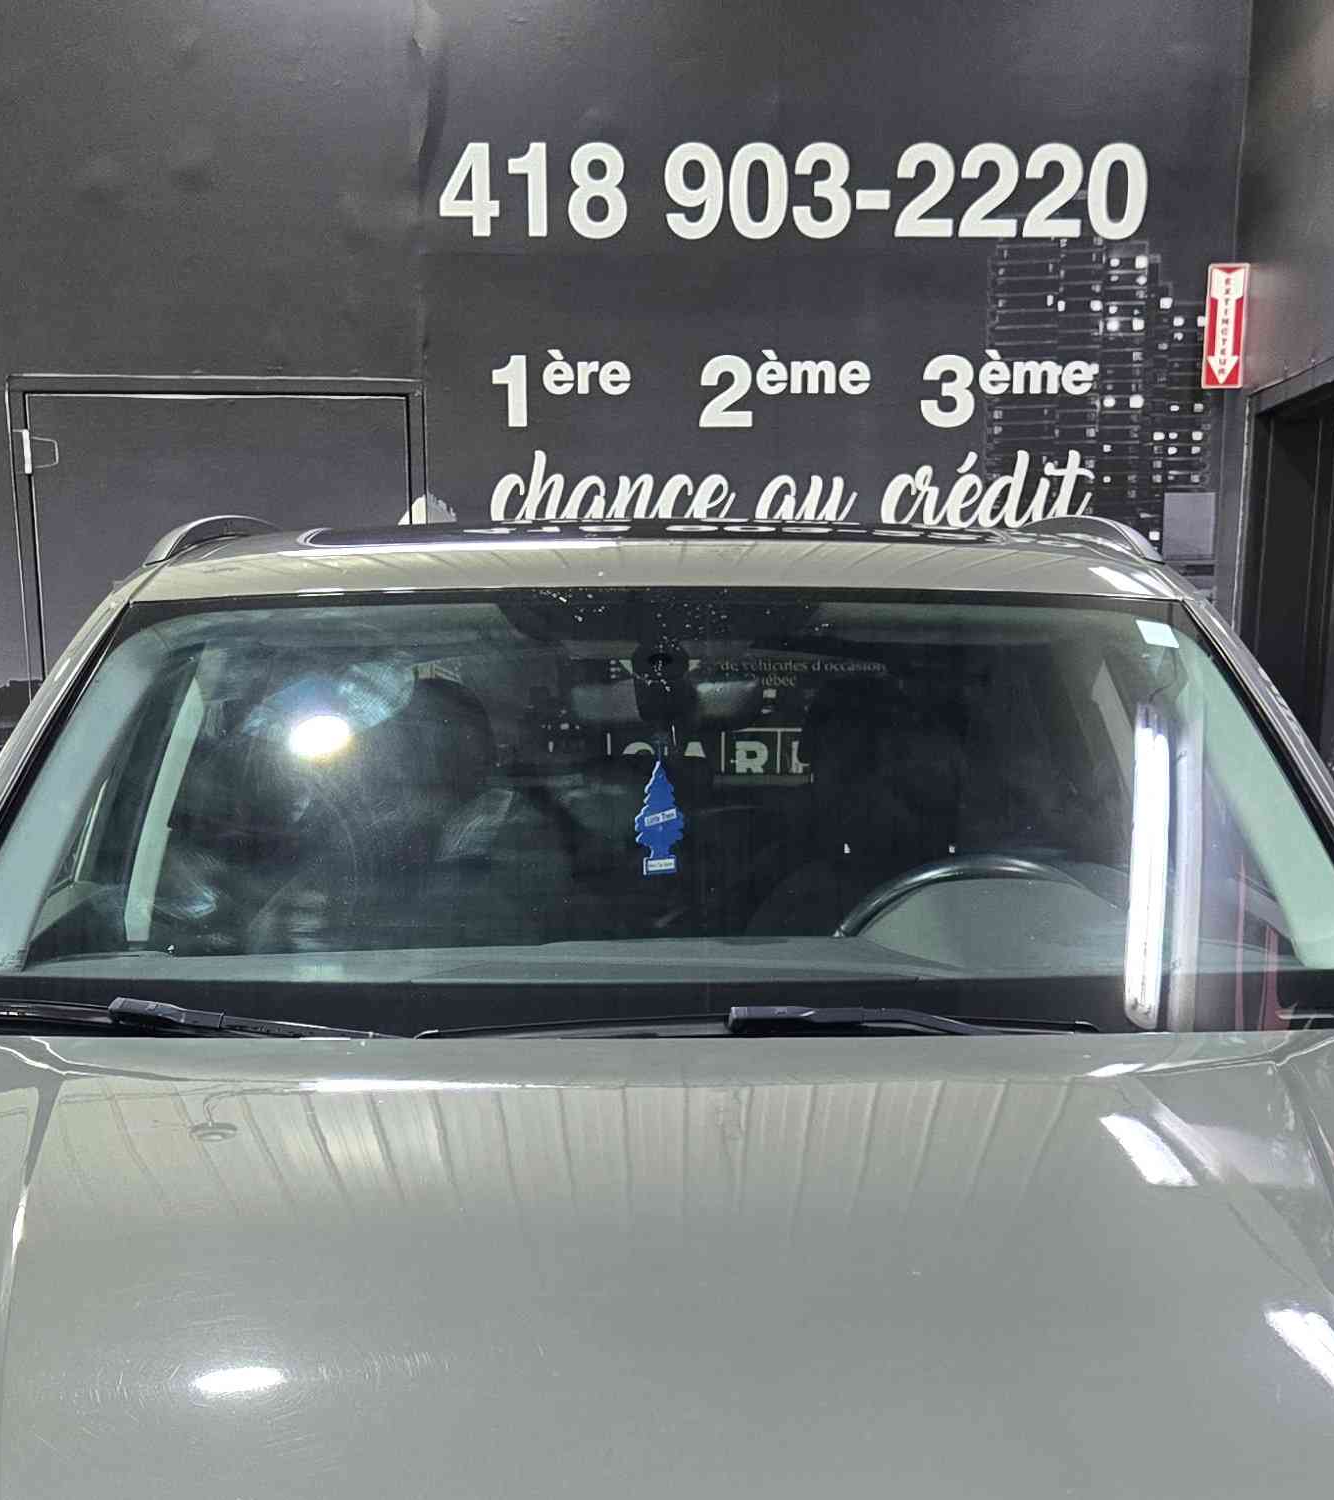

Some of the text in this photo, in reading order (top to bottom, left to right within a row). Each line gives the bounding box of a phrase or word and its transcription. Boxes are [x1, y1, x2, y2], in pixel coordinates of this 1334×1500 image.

[439, 141, 1149, 240] 418 903-2220
[1218, 277, 1232, 374] EXTINCTEUR
[491, 350, 1100, 428] 1ère 2ème 3ème
[490, 449, 1096, 530] chance au crédit
